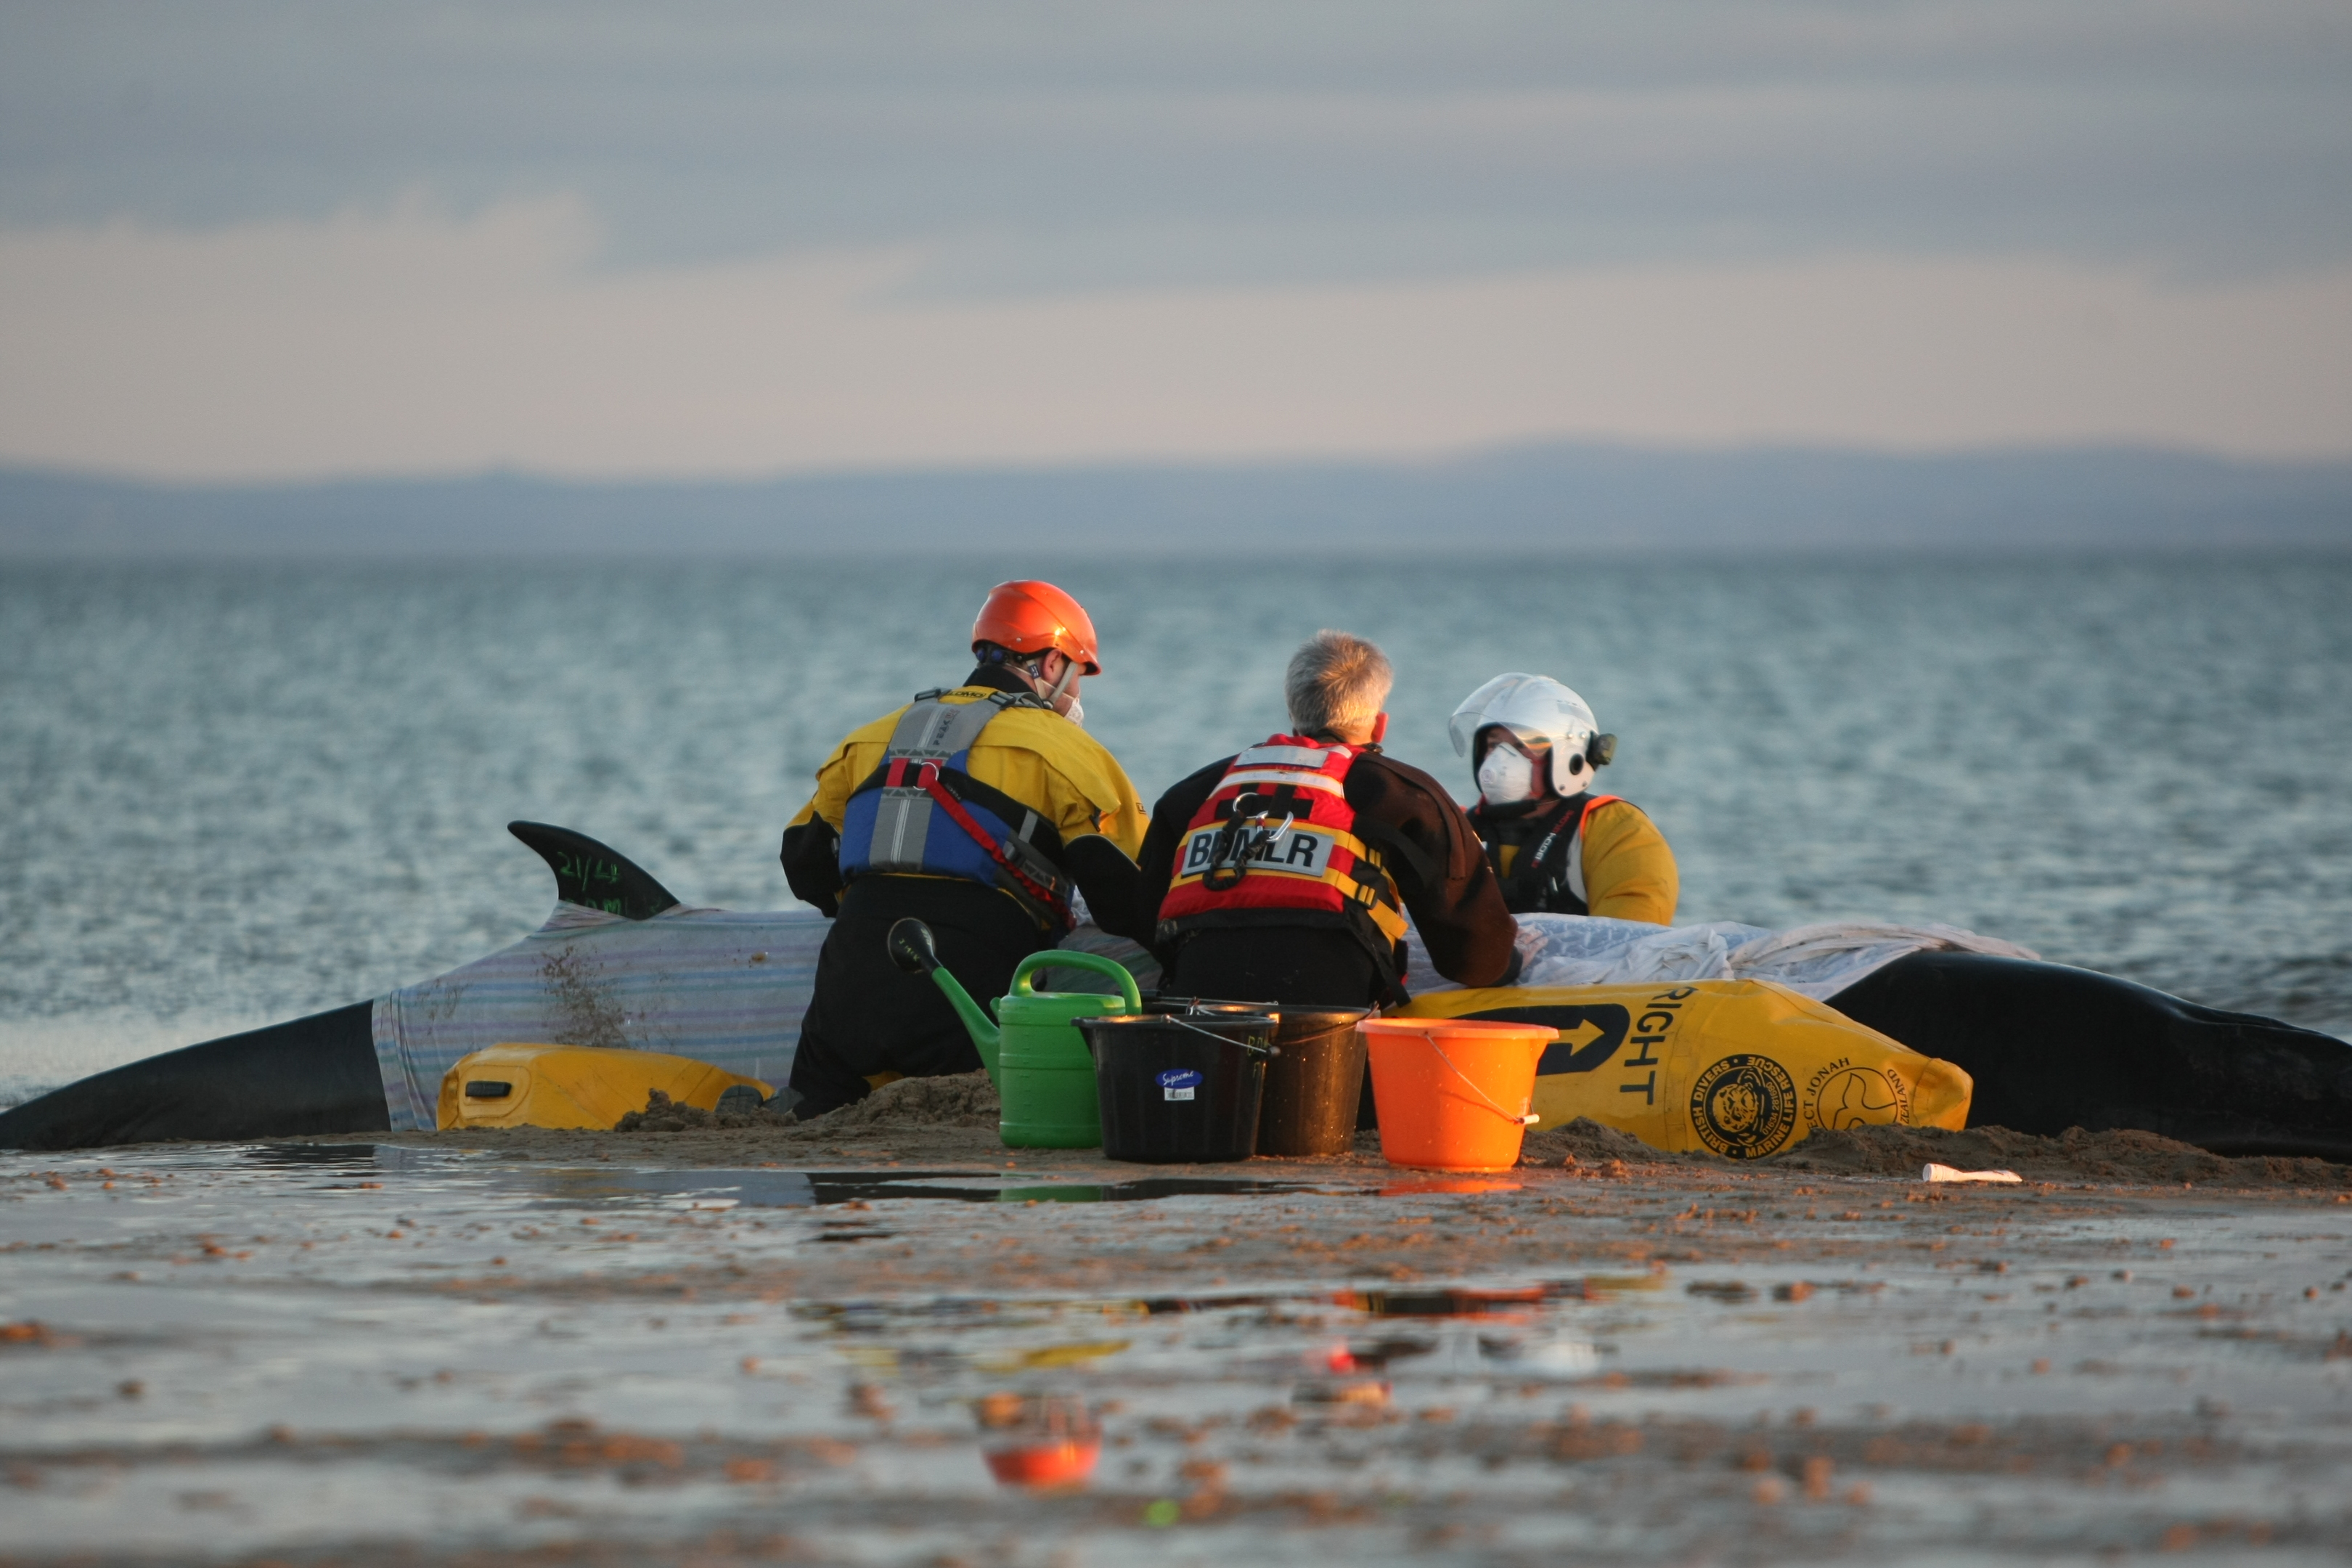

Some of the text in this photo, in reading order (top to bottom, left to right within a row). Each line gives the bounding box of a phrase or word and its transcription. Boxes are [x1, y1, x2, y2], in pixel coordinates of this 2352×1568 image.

[932, 718, 952, 746] PEAK
[1535, 832, 1556, 860] BODY
[1620, 986, 1699, 1105] RIGHT
[1162, 1070, 1194, 1087] Supreme
[1807, 1057, 1850, 1096] JONAH
[1692, 1060, 1731, 1154] BRITISH DIVERS
[1745, 1056, 1794, 1158] MARINE LIFE RESCUE
[1887, 1069, 1910, 1124] ZEALAND
[1762, 1112, 1778, 1135] 01634
